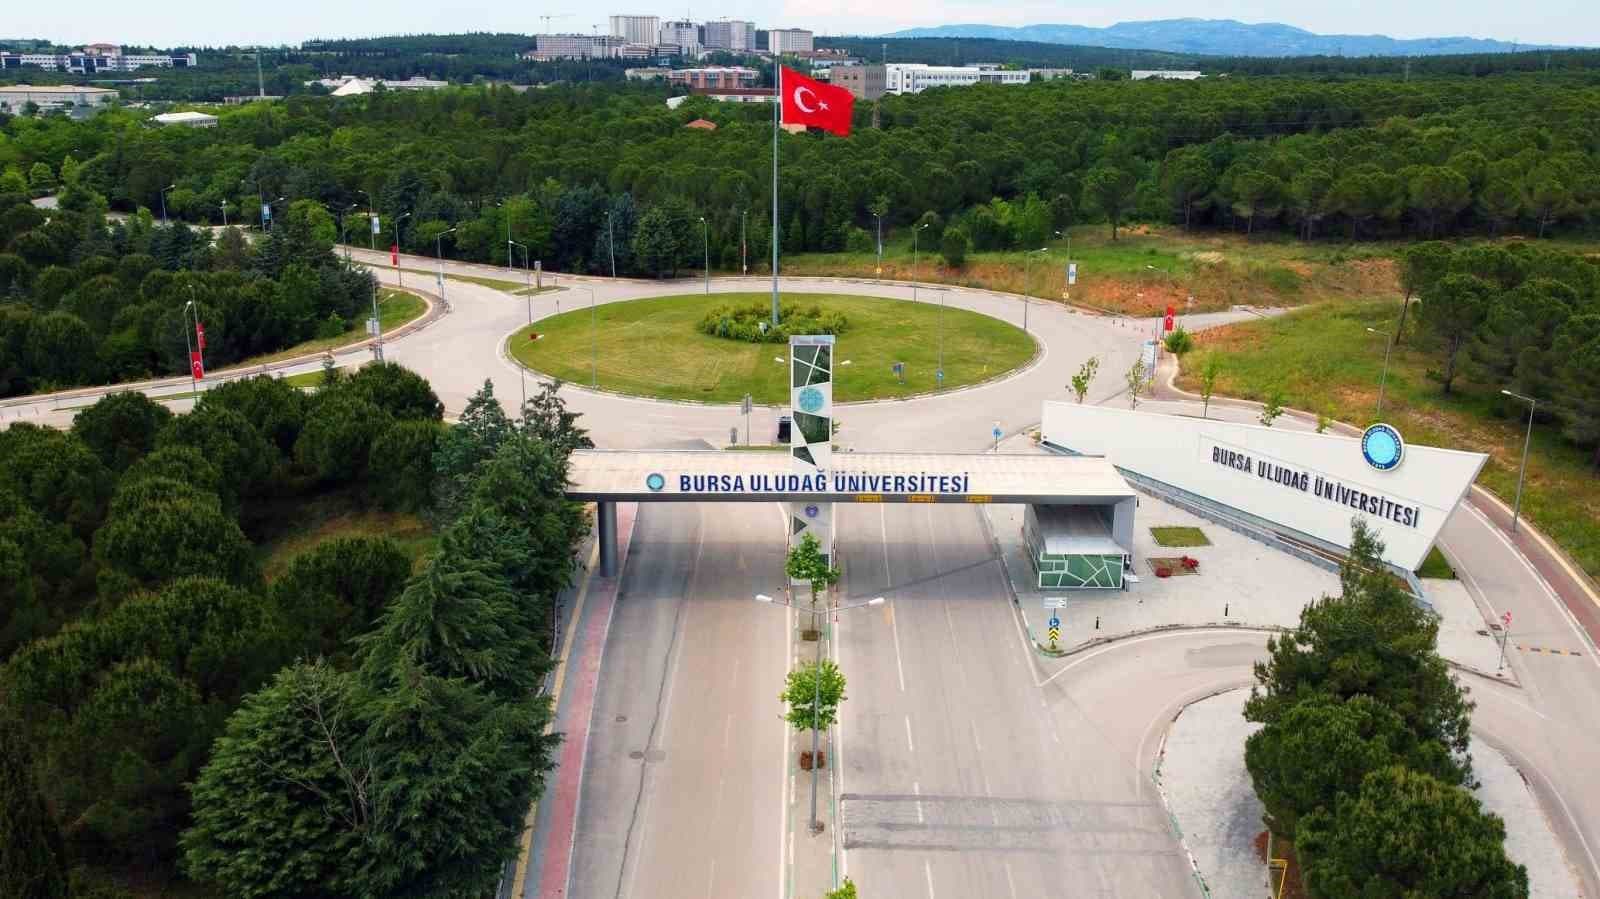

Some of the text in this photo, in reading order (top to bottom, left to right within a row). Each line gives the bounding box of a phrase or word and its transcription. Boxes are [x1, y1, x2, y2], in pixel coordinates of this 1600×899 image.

[680, 470, 968, 493] BURSA ULUDAĞ ÜNİVERSİTESİ
[1212, 446, 1419, 528] BURSA ULUDAĞ ÜNİVERSİTESİ
